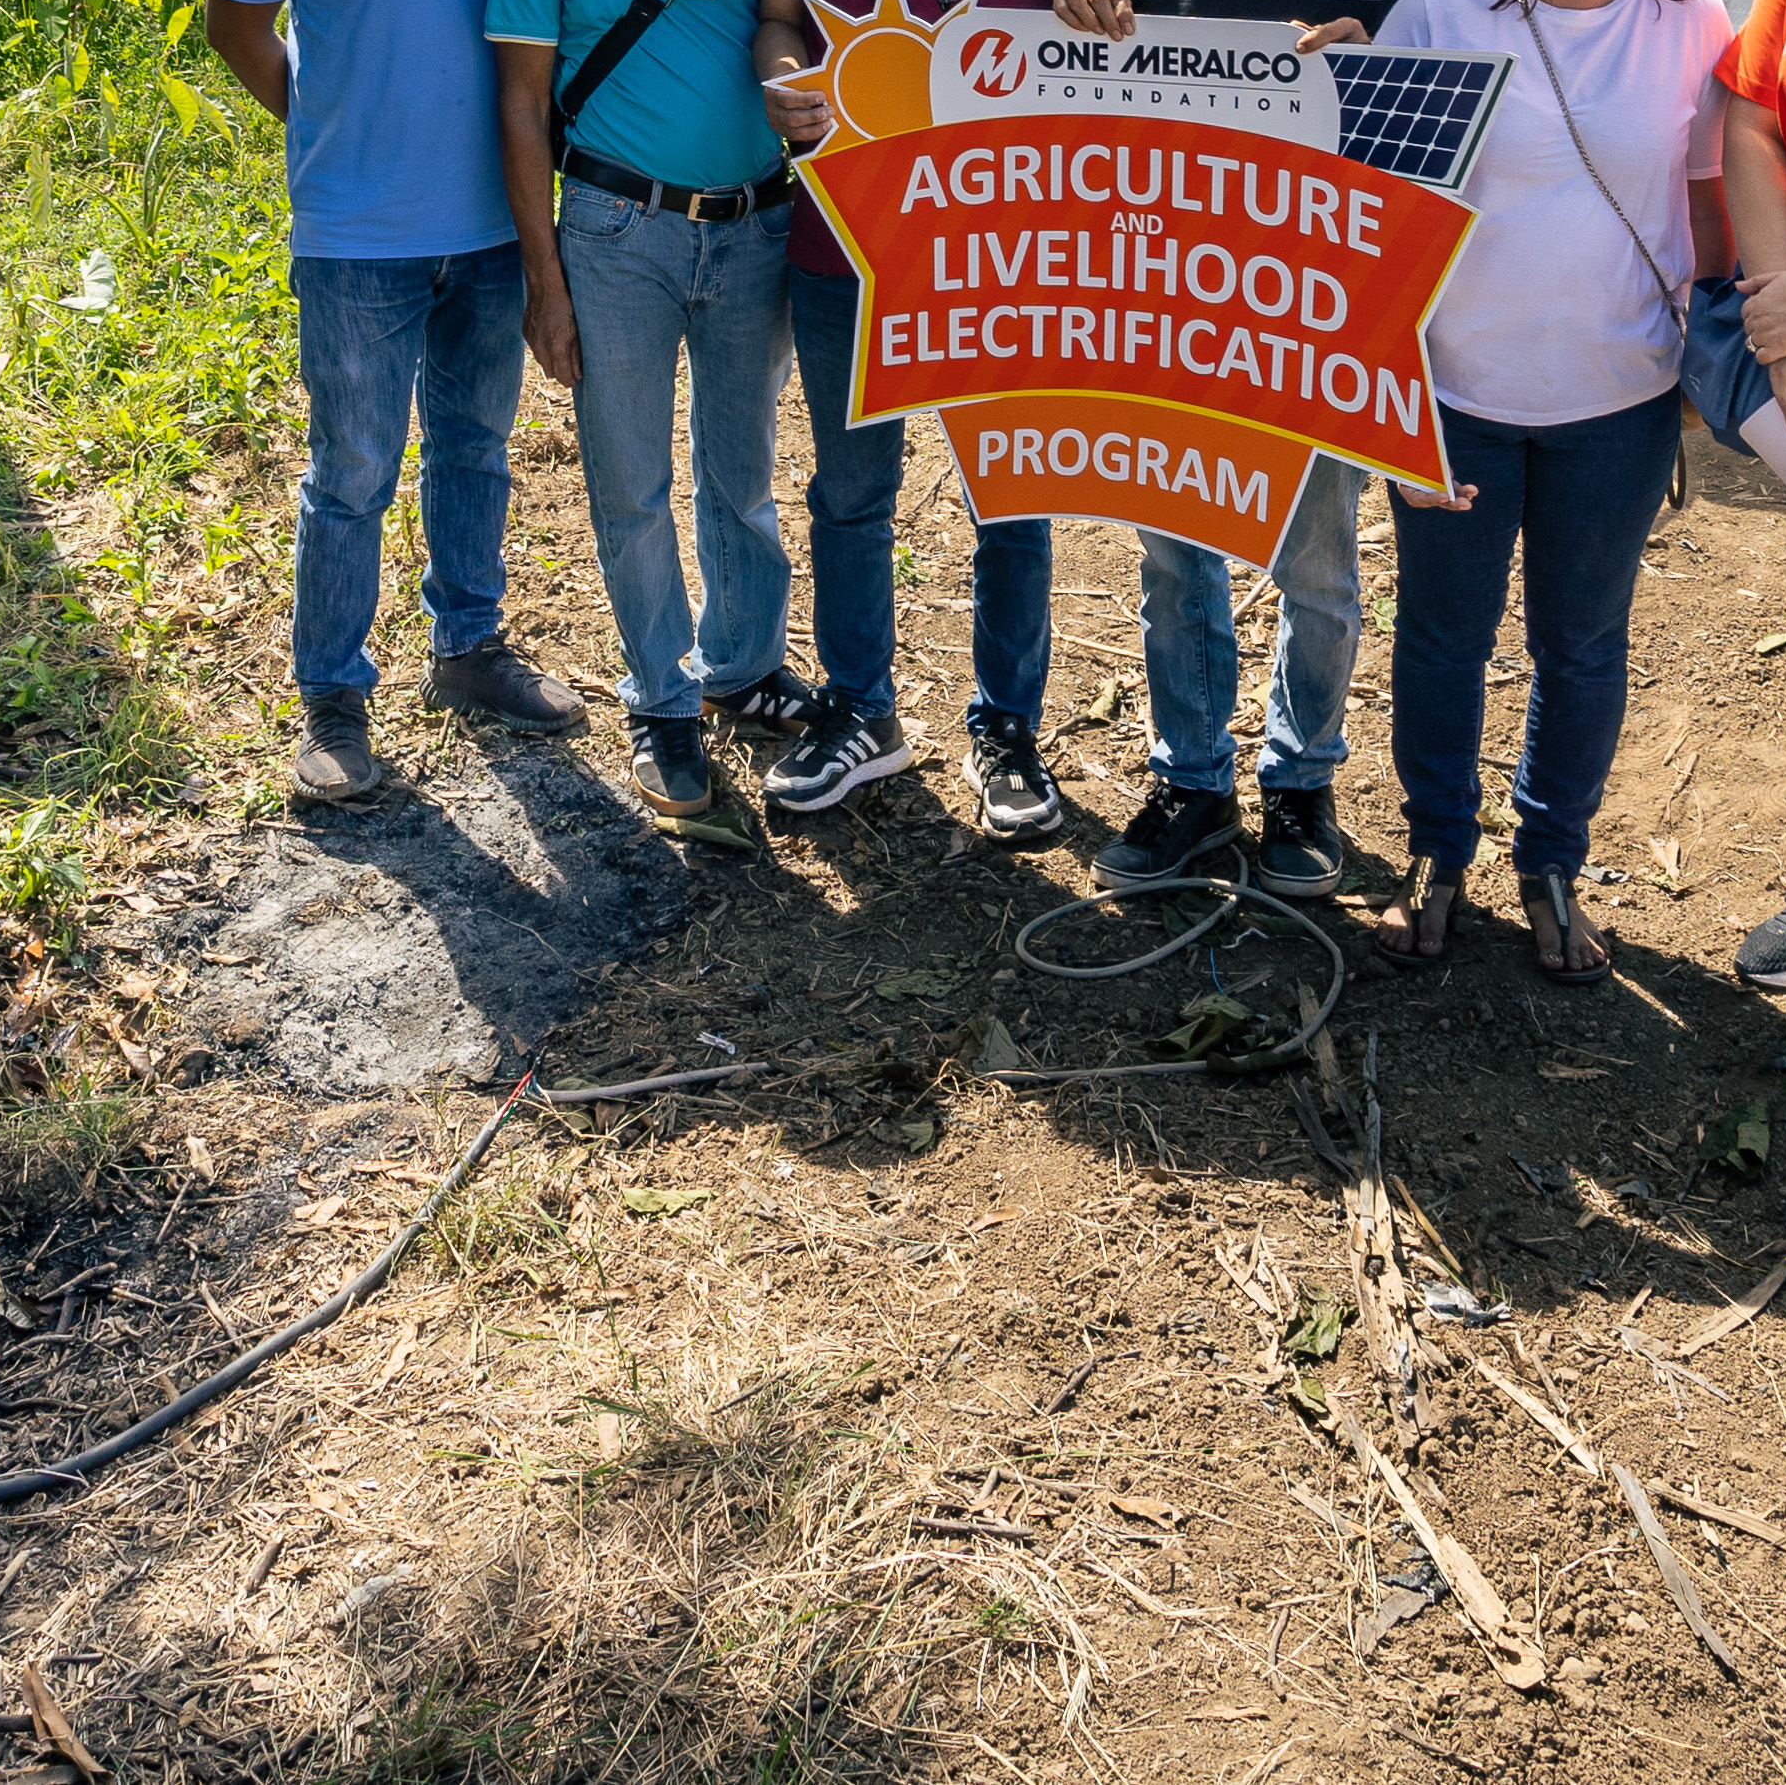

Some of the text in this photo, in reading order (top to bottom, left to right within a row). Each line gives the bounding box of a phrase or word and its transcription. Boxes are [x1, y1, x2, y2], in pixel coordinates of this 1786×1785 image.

[1037, 40, 1109, 73] ONE
[1119, 45, 1301, 84] MERALCO
[1037, 83, 1301, 114] FOUNDATION
[901, 144, 1384, 258] AGRICULTURE
[1110, 212, 1164, 235] AND
[933, 229, 1349, 333] LIVELIHOOD
[881, 305, 1421, 436] ELECTRIFICATION
[978, 428, 1270, 522] PROGRAM
